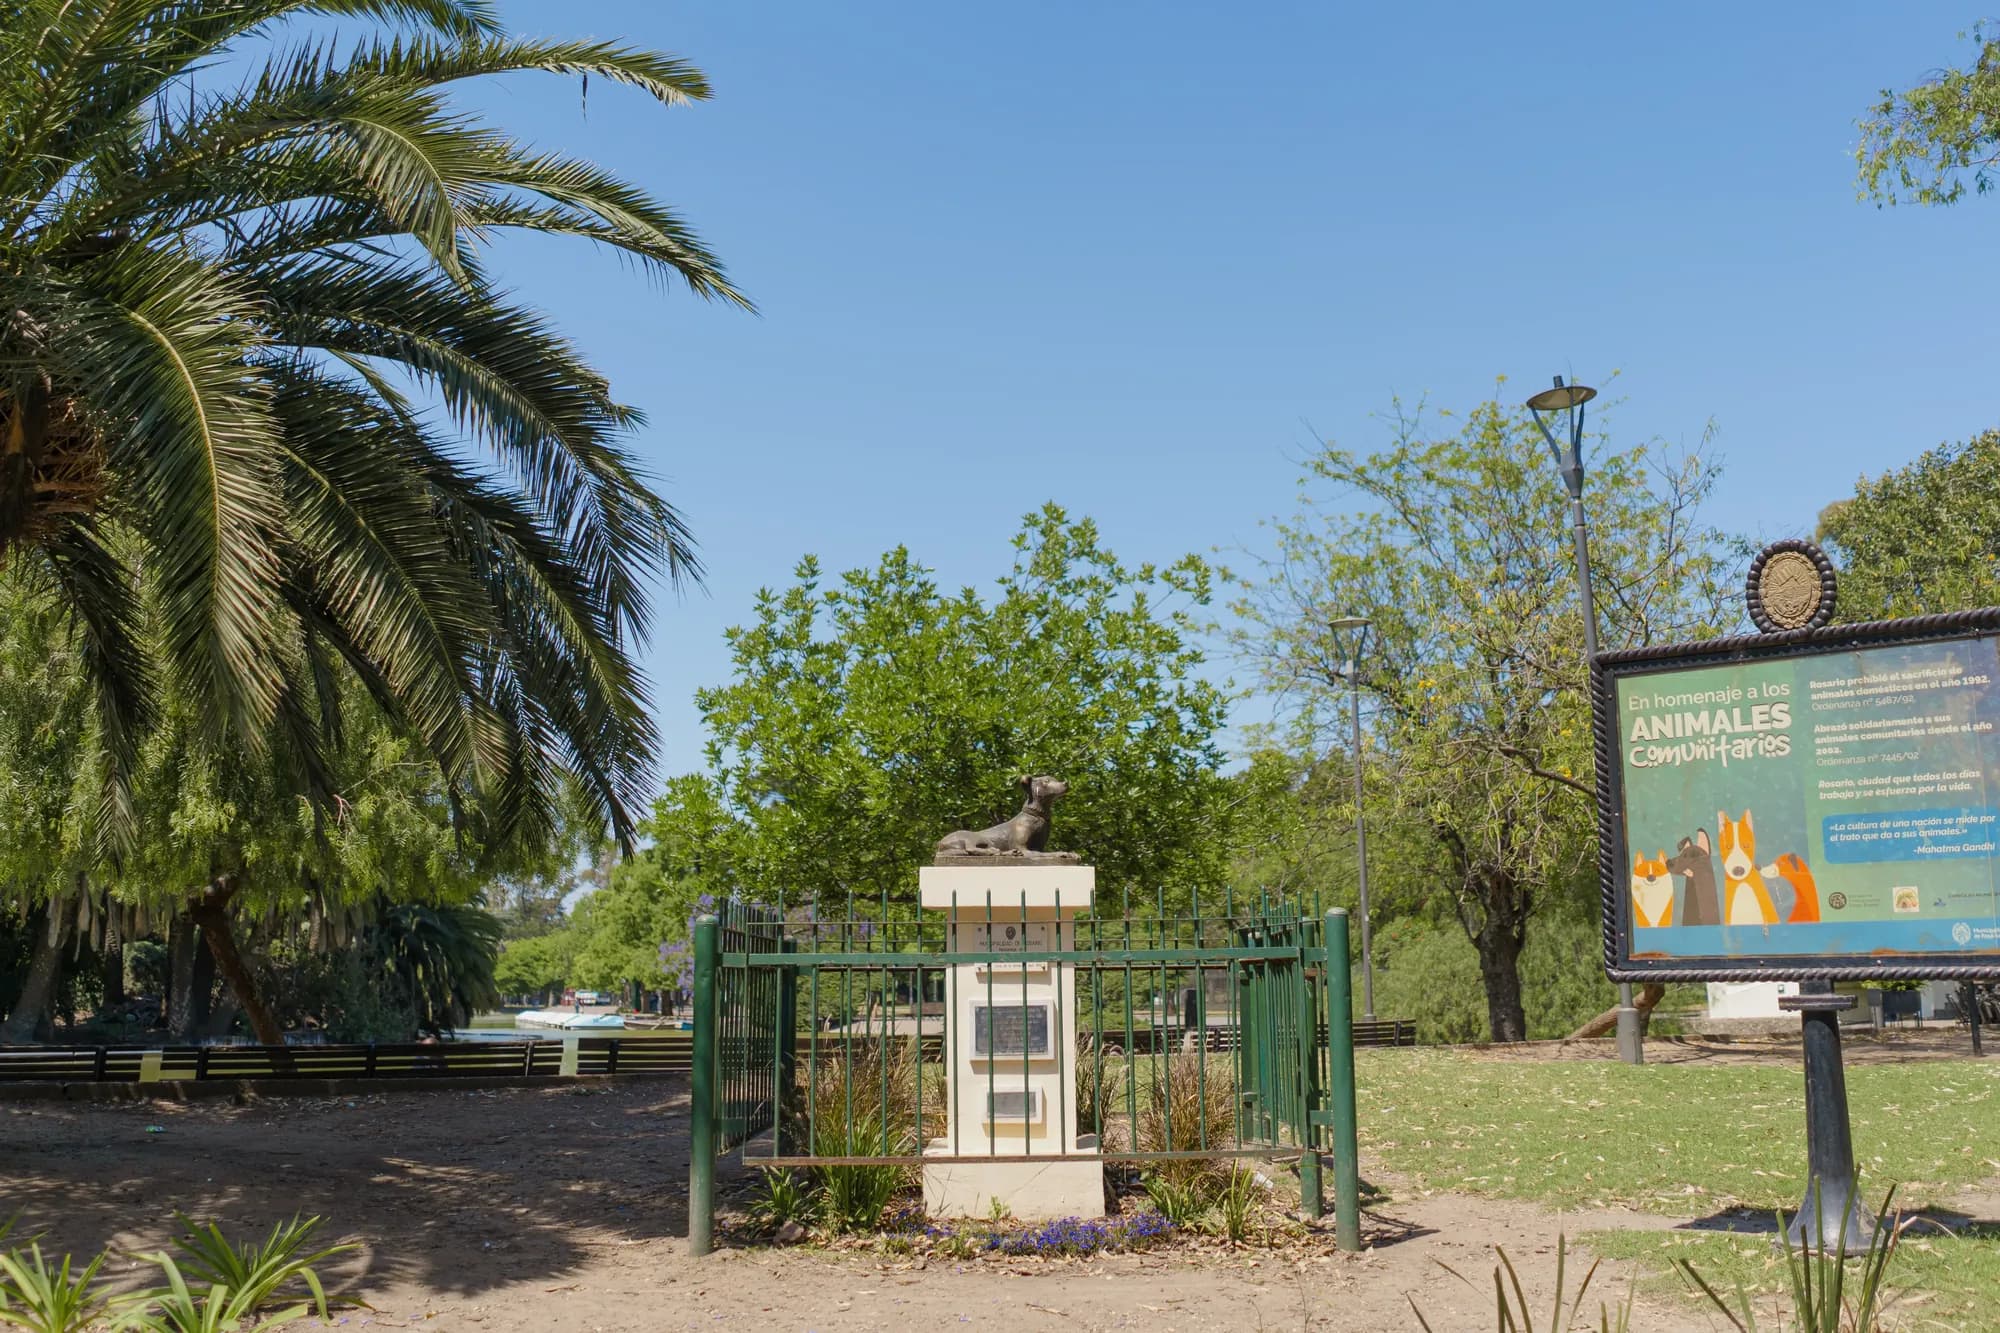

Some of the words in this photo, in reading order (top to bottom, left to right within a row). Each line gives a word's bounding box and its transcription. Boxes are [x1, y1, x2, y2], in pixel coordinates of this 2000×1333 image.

[1809, 678, 1846, 689] Rosario
[1890, 673, 1900, 681] el
[1901, 668, 1948, 681] sacrificio
[1949, 666, 1963, 675] de
[1811, 689, 1855, 700] animales
[1856, 683, 1913, 696] domésticos
[1915, 682, 1928, 690] en
[1930, 680, 1940, 689] el
[1941, 678, 1961, 688] año
[1962, 675, 1991, 685] 1992.
[1628, 696, 1650, 710] En
[1654, 686, 1743, 708] homenaje
[1747, 687, 1758, 699] a
[1762, 682, 1791, 697] los
[1630, 702, 1792, 742] ANIMALES
[1814, 723, 1847, 733] Abrazó
[1849, 716, 1924, 730] solidariamente
[1925, 716, 1933, 724] a
[1934, 714, 1952, 723] sus
[1814, 733, 1859, 744] animales
[1860, 727, 1926, 741] comunitarios
[1927, 724, 1960, 735] desde
[1961, 723, 1971, 732] el
[1973, 721, 1992, 731] año
[1629, 733, 1792, 768] comunitarios
[1857, 775, 1891, 786] ciudad
[1893, 774, 1911, 785] que
[1912, 771, 1941, 782] todos
[1942, 770, 1957, 780] los
[1959, 768, 1981, 779] días
[1819, 790, 1855, 800] trabaja
[1855, 791, 1861, 800] y
[1863, 789, 1874, 797] se
[1875, 786, 1917, 797] esfuerza
[1918, 785, 1935, 795] por
[1936, 783, 1947, 792] la
[1948, 782, 1973, 791] vida.
[1847, 820, 1878, 830] cultura
[1879, 819, 1891, 828] de
[1892, 820, 1910, 828] una
[1911, 817, 1942, 827] nación
[1955, 815, 1977, 825] mide
[1979, 815, 1996, 824] por
[1830, 833, 1838, 842] el
[1839, 832, 1861, 841] trato
[1862, 832, 1879, 842] que
[1880, 830, 1892, 839] da
[1901, 830, 1917, 839] sus
[1962, 841, 1995, 851] Gandhi
